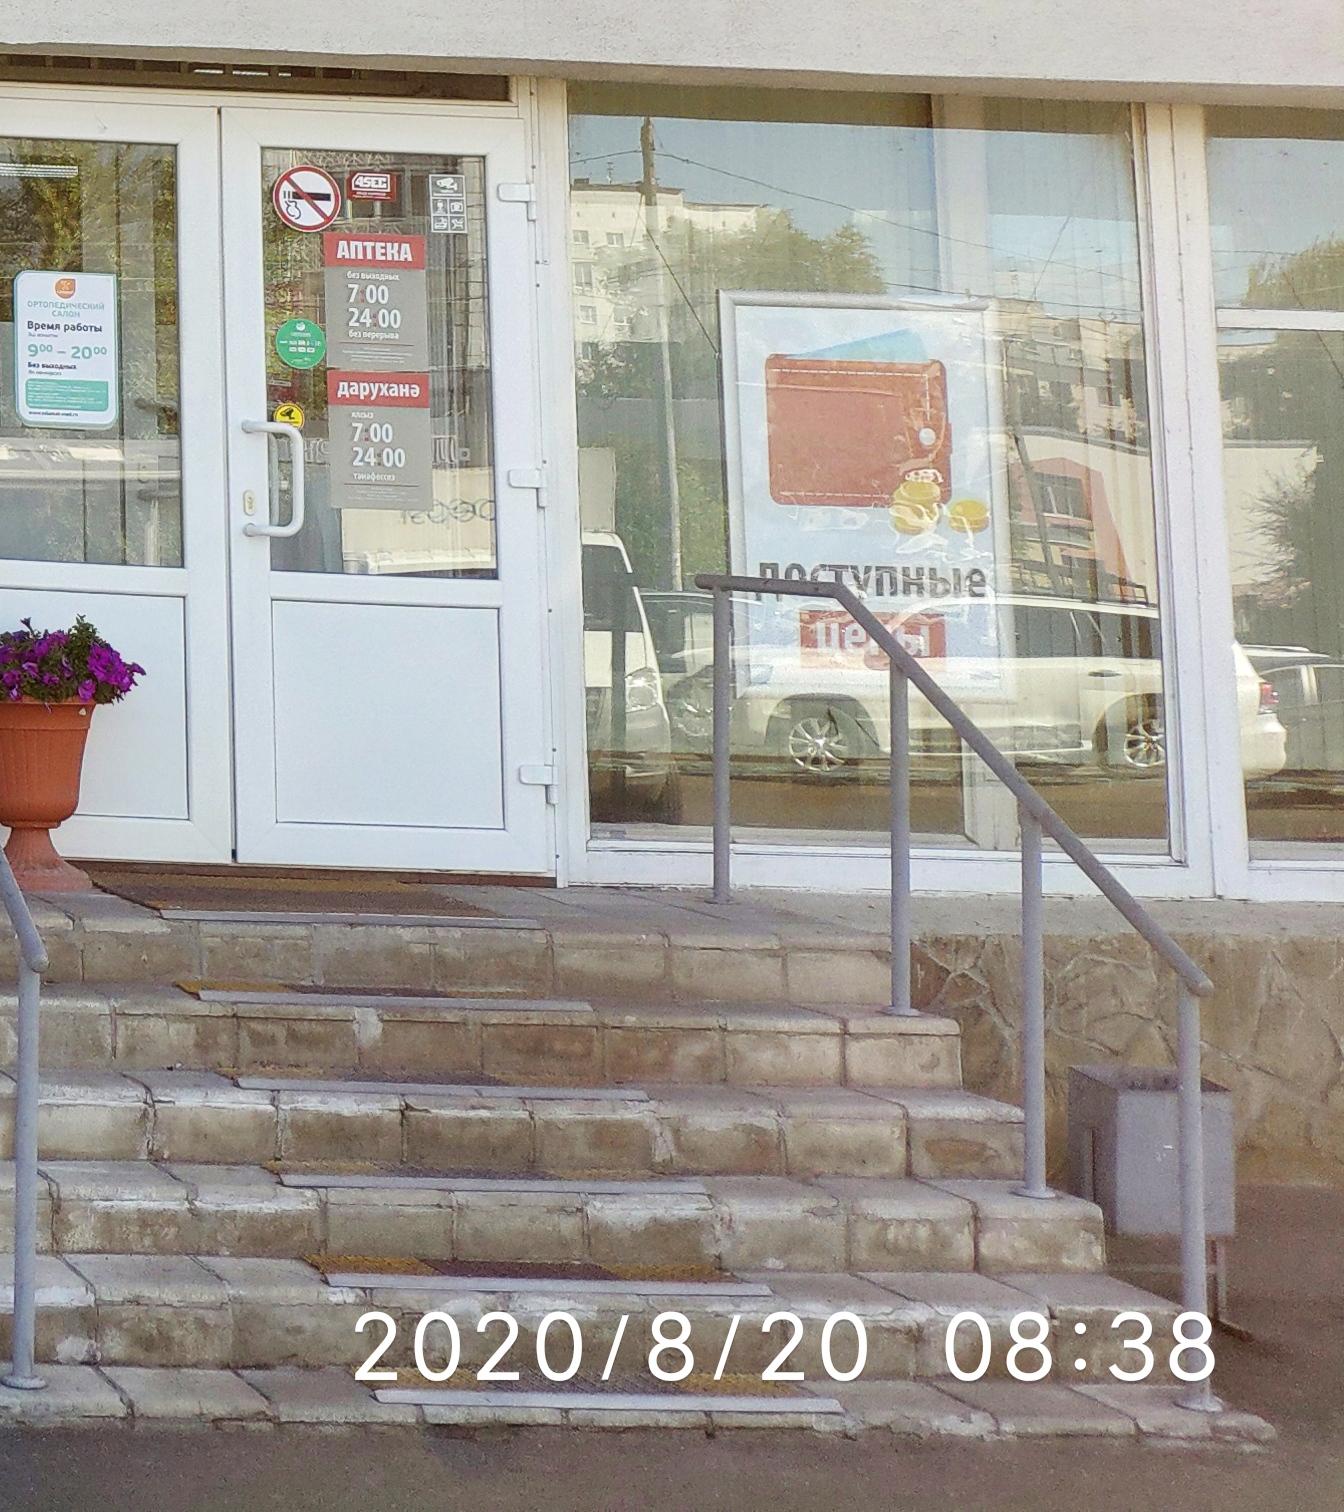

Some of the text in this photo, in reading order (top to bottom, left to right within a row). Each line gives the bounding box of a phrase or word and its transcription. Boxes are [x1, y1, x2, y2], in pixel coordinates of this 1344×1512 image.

[336, 240, 412, 262] АПТЕКА
[347, 271, 359, 279] без
[347, 284, 389, 304] 7:00
[27, 300, 105, 310] ОРТОПЕДИЧЕСКИЙ
[52, 310, 80, 318] САЛОН
[27, 321, 102, 333] Время работы
[348, 308, 401, 328] 24:00
[348, 329, 361, 338] без
[337, 381, 420, 400] даруханә
[352, 423, 393, 443] 7:00
[352, 447, 406, 467] 24:00
